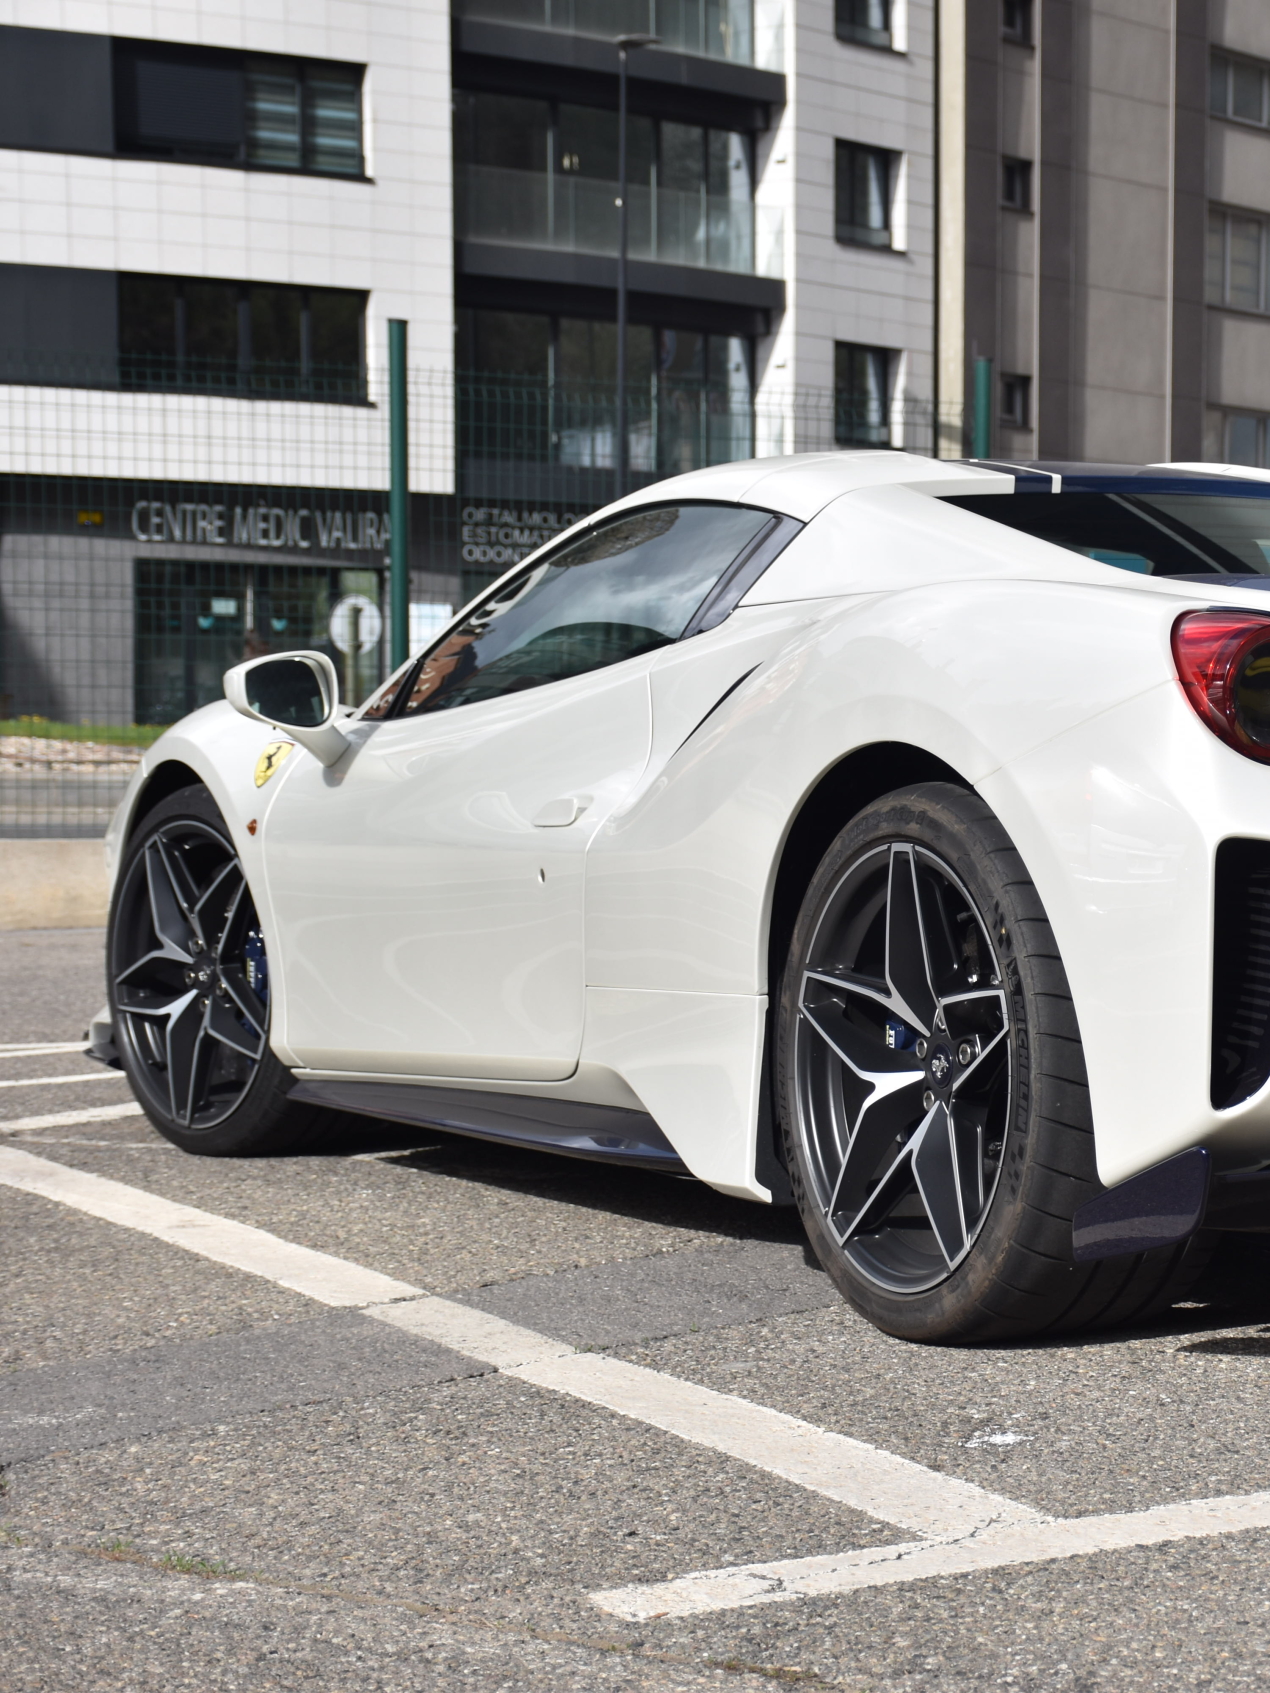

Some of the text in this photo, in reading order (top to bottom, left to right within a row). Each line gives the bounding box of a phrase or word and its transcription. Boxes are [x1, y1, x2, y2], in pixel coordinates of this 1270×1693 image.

[131, 500, 227, 543] CENTRE
[315, 509, 391, 550] VALIRA
[1013, 995, 1029, 1132] MICHELIN
